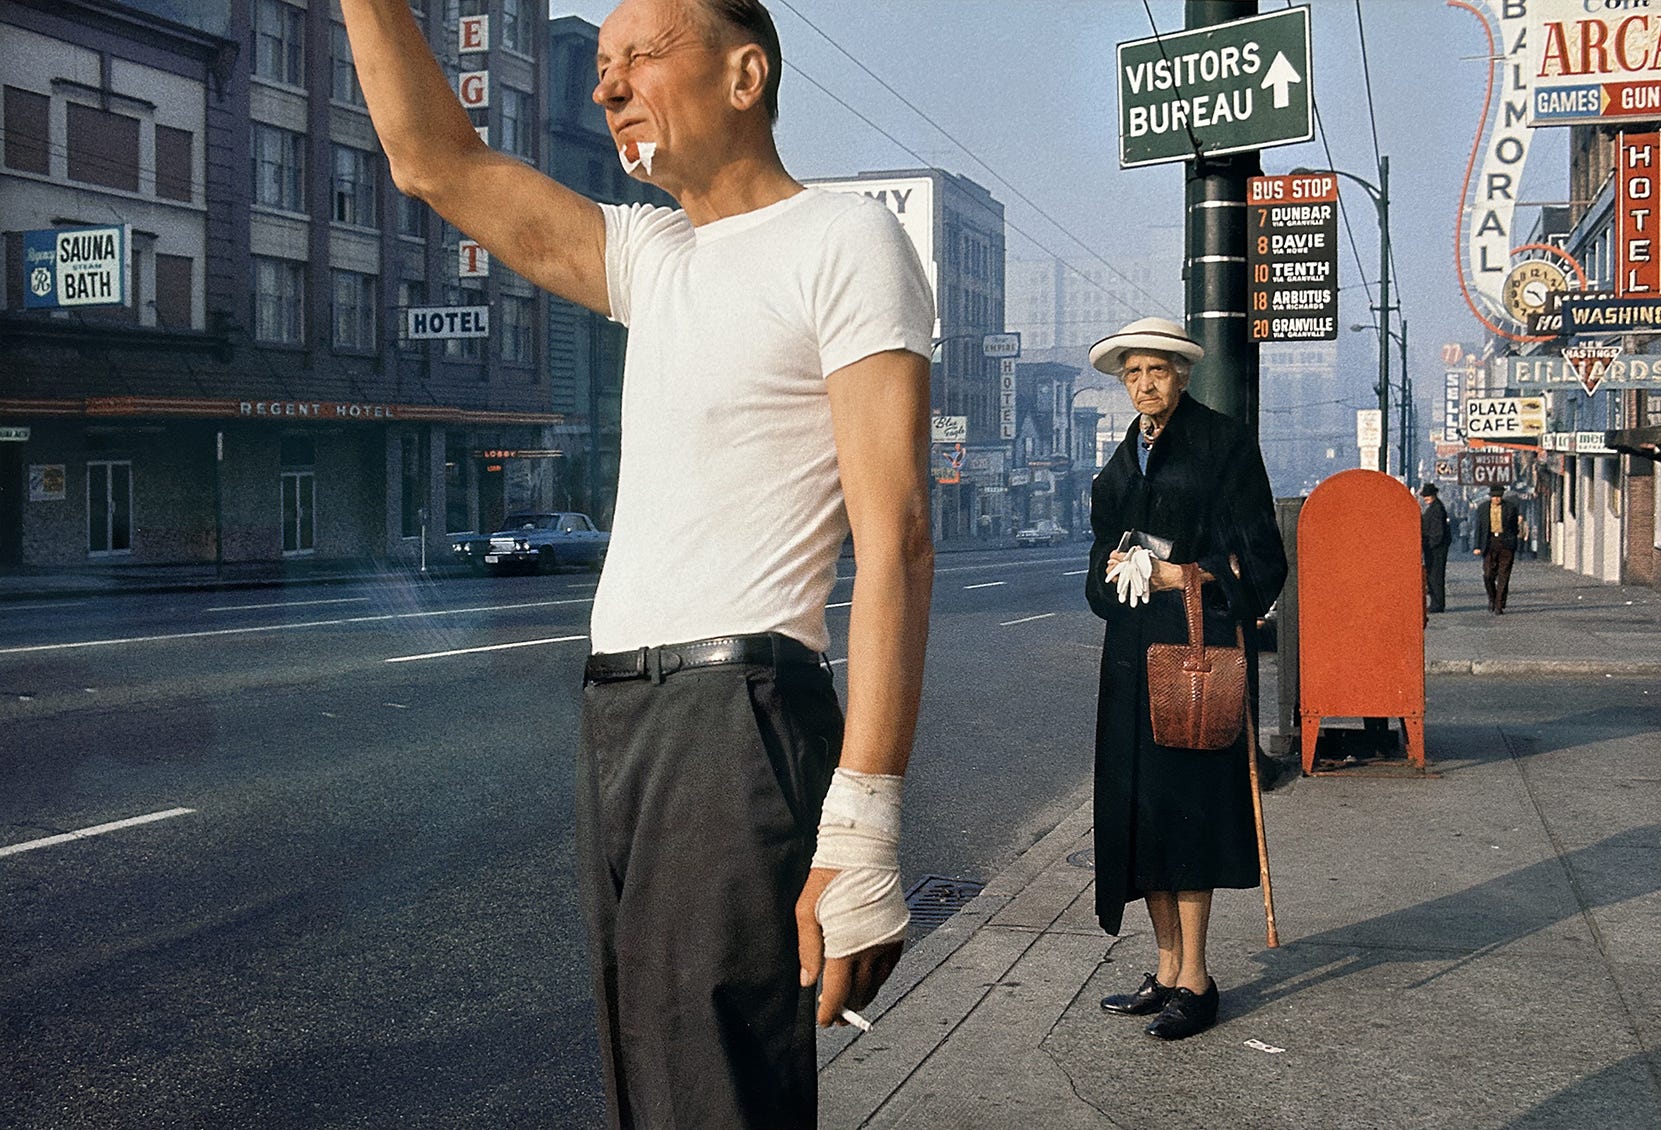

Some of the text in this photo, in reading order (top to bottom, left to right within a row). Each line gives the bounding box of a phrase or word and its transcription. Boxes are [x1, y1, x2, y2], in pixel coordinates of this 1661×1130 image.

[1126, 42, 1261, 94] VISITORS
[1537, 90, 1599, 112] GAMES
[1129, 88, 1253, 137] BUREAU
[1252, 178, 1332, 200] BUS STOP
[1258, 205, 1331, 227] 7 DUNBAR
[1629, 145, 1651, 293] HOTEL
[60, 234, 116, 263] SAUNA
[1257, 233, 1325, 254] 8 DAVIE
[1254, 262, 1330, 283] 10 TENTH
[65, 271, 112, 299] BATH
[1253, 290, 1331, 310] 18 ARBUTUS
[414, 312, 486, 333] HOTEL
[1253, 318, 1333, 338] 20 GRANVILLE
[1565, 348, 1619, 359] HASTINGS
[1579, 340, 1605, 348] NEW
[240, 402, 393, 417] REGENT HOTEL
[1003, 360, 1012, 438] HOTEL
[1469, 402, 1519, 415] PLAZA
[933, 417, 957, 429] Blue
[1469, 418, 1520, 432] CAFE
[484, 450, 517, 458] LOBBY
[1475, 455, 1510, 464] WESTERN
[1475, 465, 1510, 483] GYM
